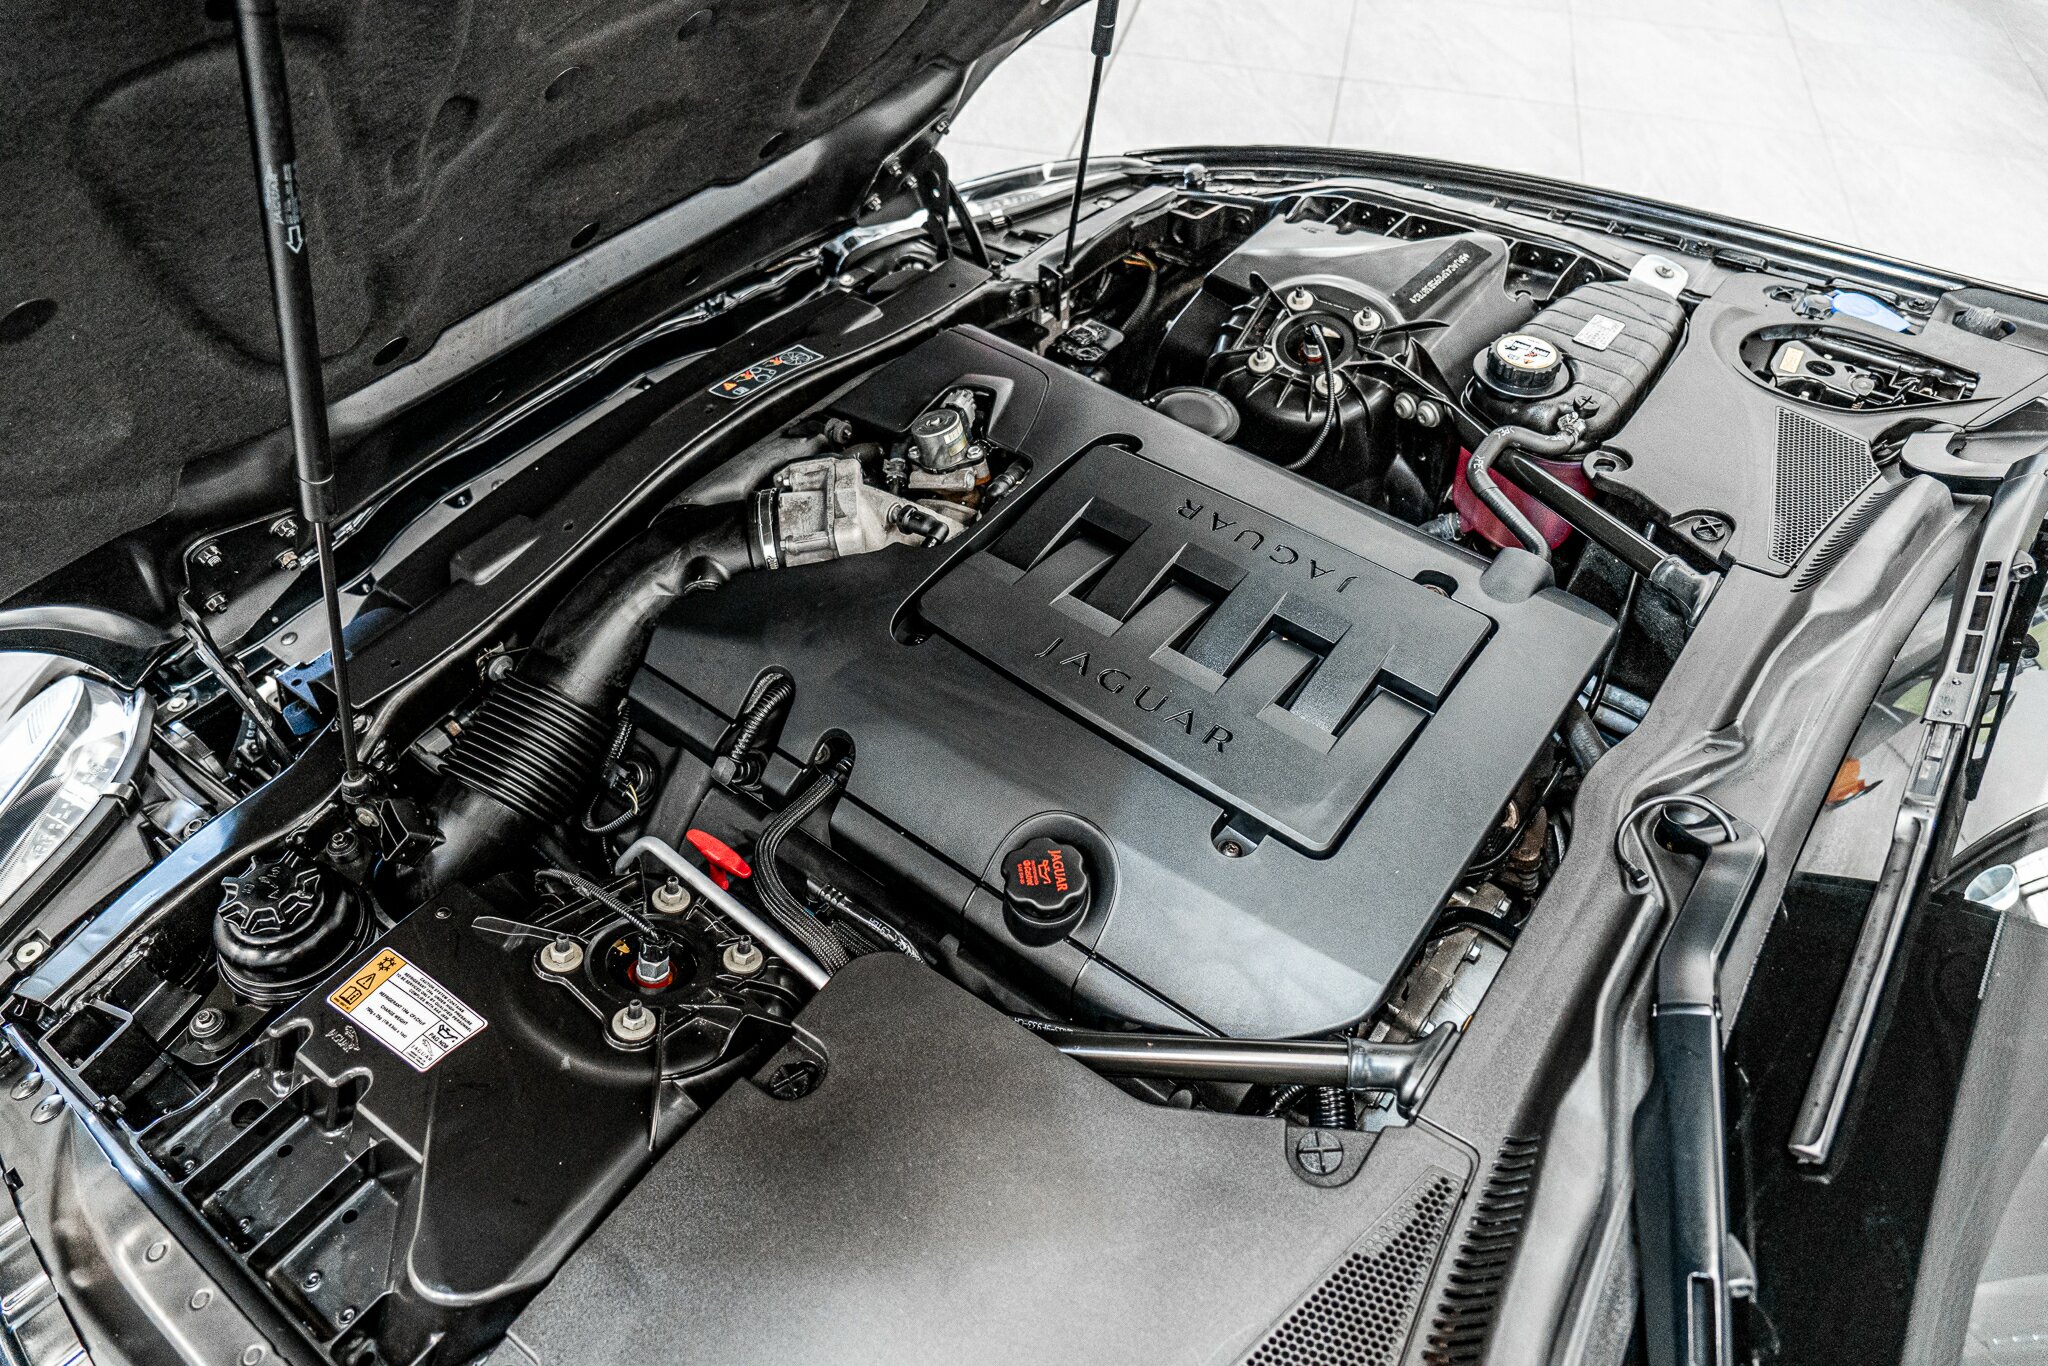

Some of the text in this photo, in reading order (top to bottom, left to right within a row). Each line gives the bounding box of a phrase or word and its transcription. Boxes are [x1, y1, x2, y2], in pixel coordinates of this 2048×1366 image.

[1176, 499, 1359, 593] JAGUAR
[1034, 637, 1234, 753] JAGUAR
[1047, 849, 1069, 893] JAGUAR
[411, 1045, 433, 1061] JAGUAR
[429, 1033, 440, 1041] PAG
